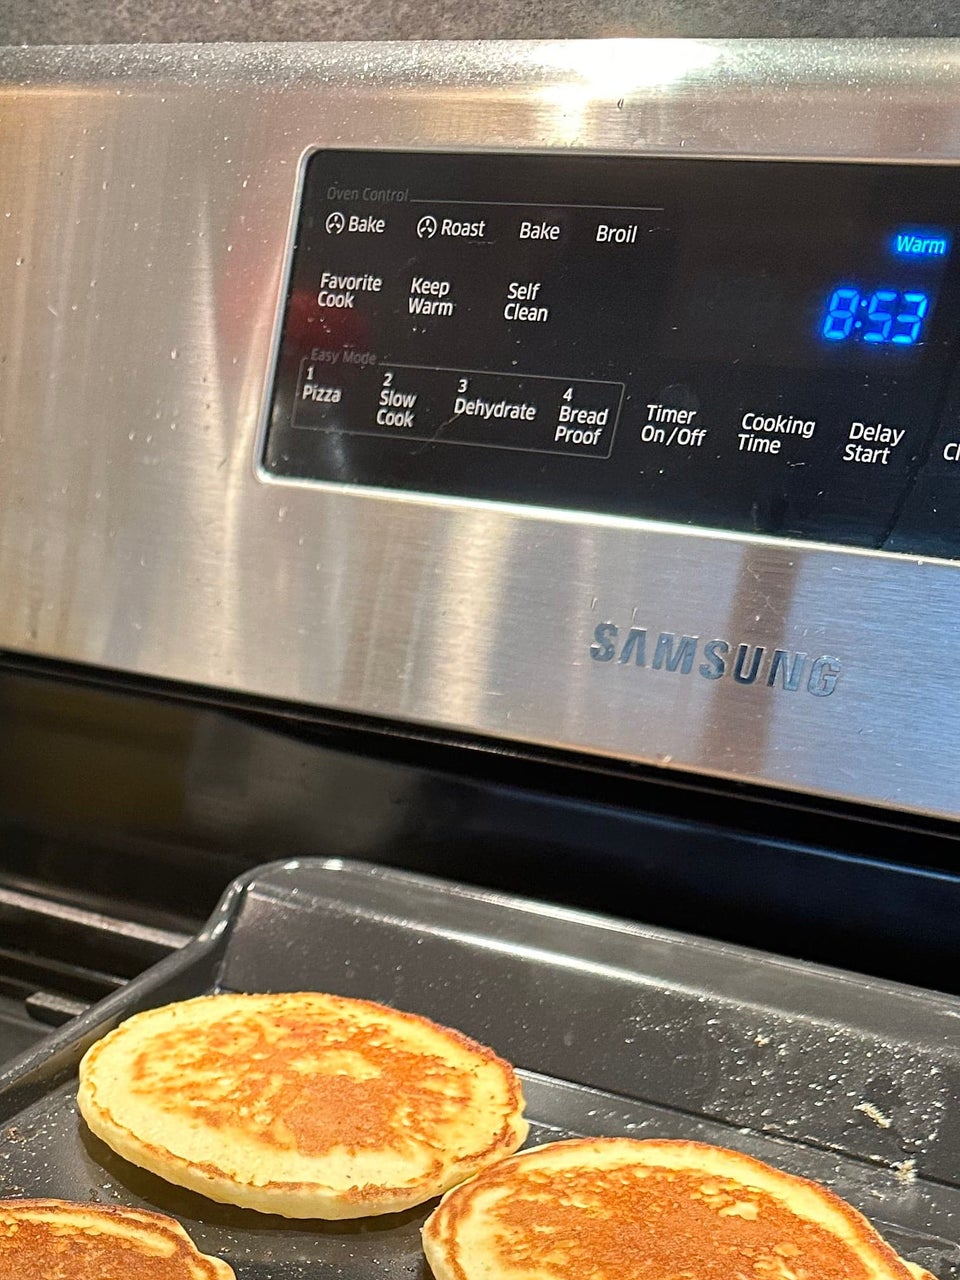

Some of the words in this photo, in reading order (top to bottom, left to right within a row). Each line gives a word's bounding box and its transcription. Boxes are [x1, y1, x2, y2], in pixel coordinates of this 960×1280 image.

[327, 187, 358, 201] Oven
[362, 187, 409, 202] Control
[348, 216, 386, 234] Bake
[441, 219, 486, 238] Roast
[519, 222, 561, 241] Bake
[596, 225, 638, 244] Broil
[897, 235, 945, 254] Warm
[320, 273, 383, 292] Favorite
[410, 277, 450, 298] Keep
[507, 282, 541, 301] Self
[317, 291, 354, 309] Cook
[408, 298, 454, 317] Warm
[503, 303, 549, 323] Clean
[823, 288, 928, 344] 8:53
[310, 349, 341, 367] Easy
[342, 350, 377, 367] Mode
[306, 366, 315, 380] 1
[382, 373, 394, 387] 2
[302, 385, 342, 404] Pizza
[457, 379, 468, 393] 3
[562, 387, 574, 402] 4
[379, 390, 417, 408] Slow
[376, 409, 414, 428] Cook
[454, 399, 537, 421] Dehydrate
[558, 405, 609, 426] Bread
[646, 404, 697, 425] Timer
[741, 412, 816, 439] Cooking
[848, 422, 905, 447] Delay
[554, 426, 602, 445] Proof
[738, 433, 781, 454] Time
[843, 443, 891, 465] Start
[590, 621, 841, 698] SAMSUNG
